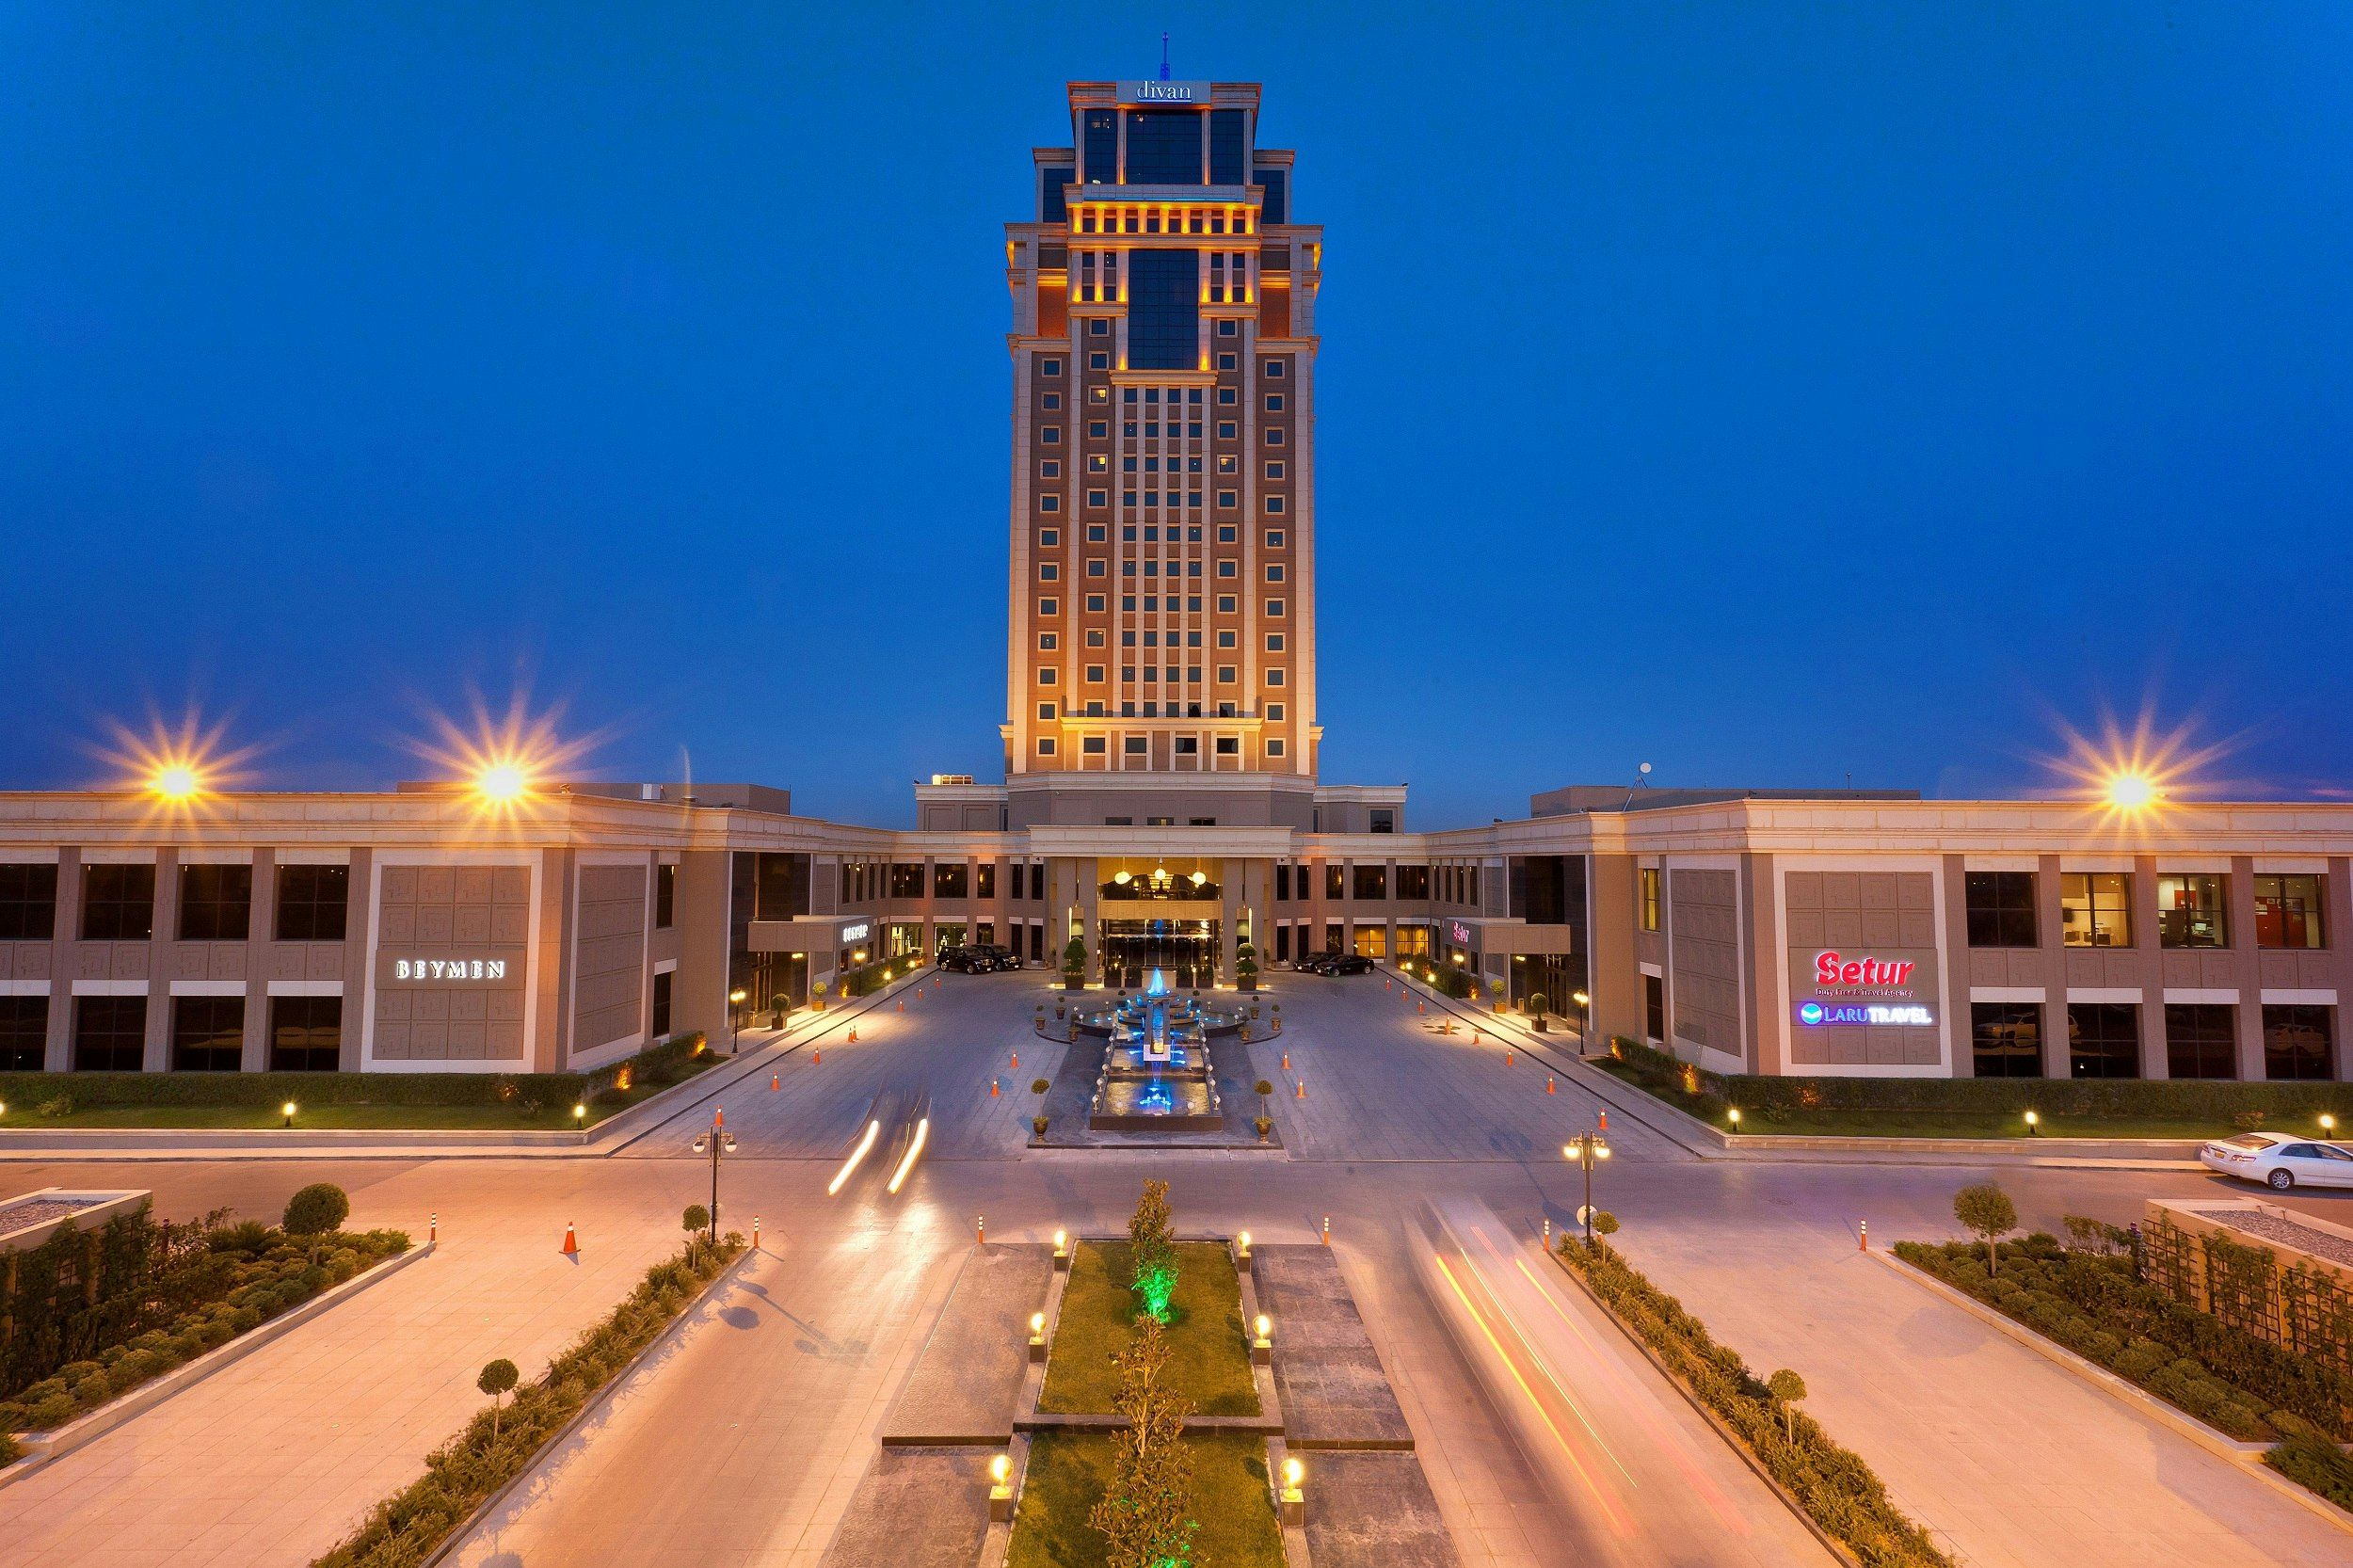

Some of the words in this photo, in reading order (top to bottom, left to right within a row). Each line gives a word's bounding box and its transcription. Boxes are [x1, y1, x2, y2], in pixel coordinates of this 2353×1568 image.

[1137, 81, 1191, 99] divan
[396, 960, 505, 979] BEYMEN
[1816, 951, 1914, 985] Setur
[1816, 988, 1834, 998] Duty
[1885, 988, 1914, 998] Agency
